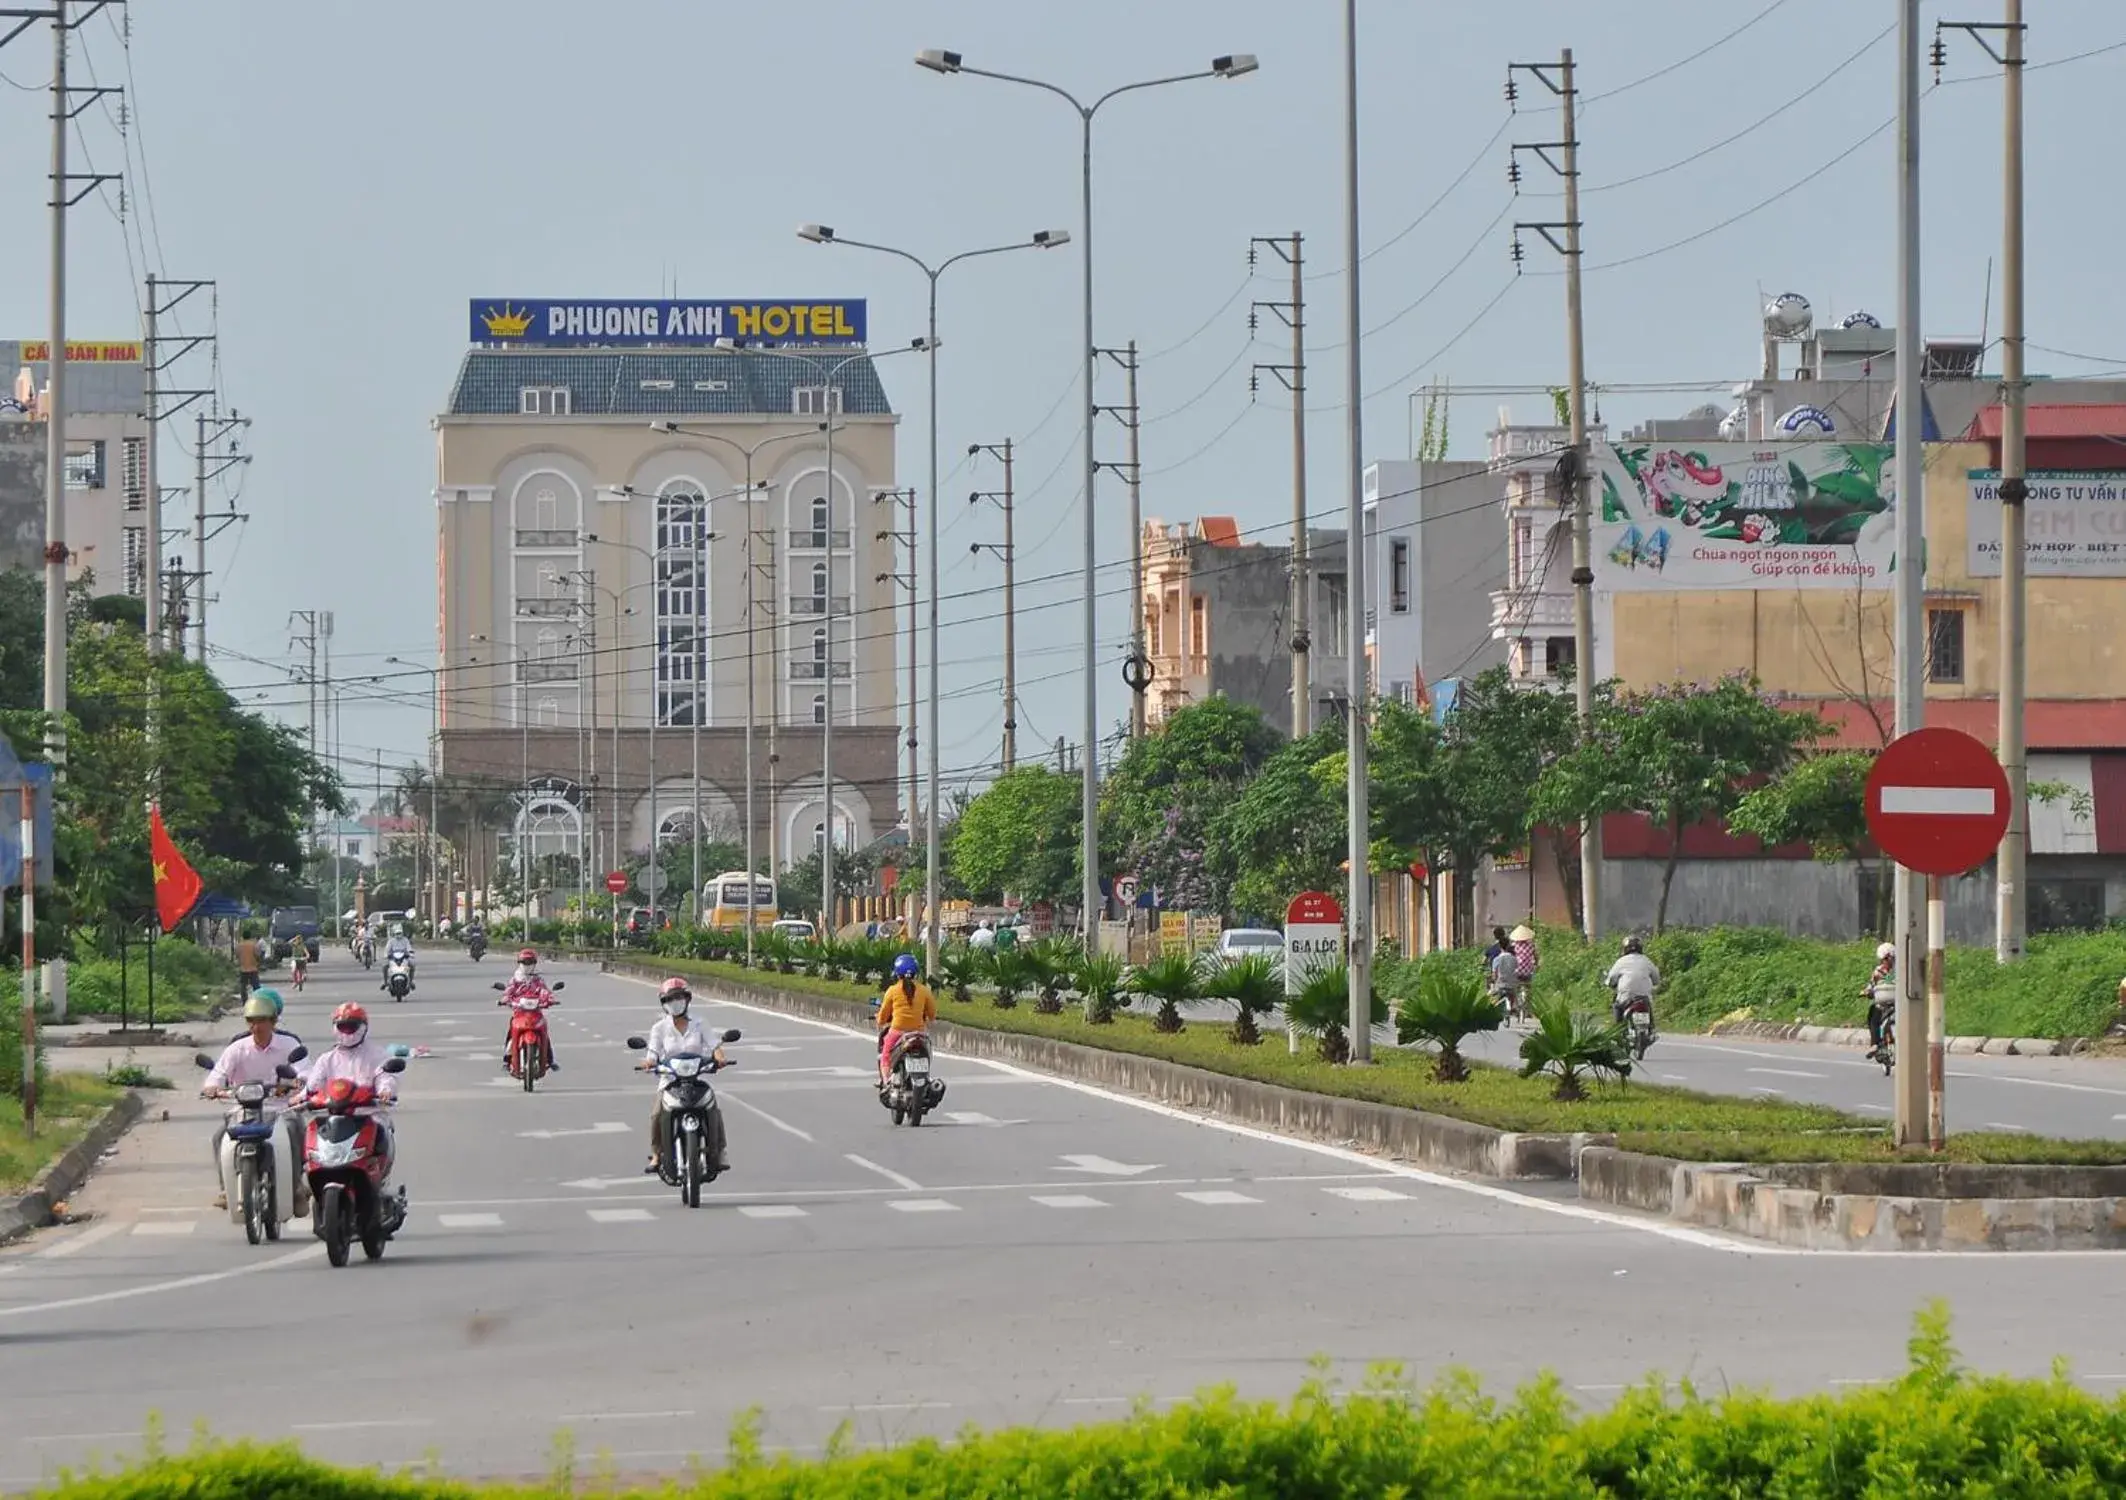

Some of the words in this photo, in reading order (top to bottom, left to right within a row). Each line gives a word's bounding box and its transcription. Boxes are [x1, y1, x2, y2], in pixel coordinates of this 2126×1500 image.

[549, 306, 659, 336] PHUONG
[729, 305, 854, 336] HOTEL
[2026, 482, 2061, 500] ÒNG
[1787, 564, 1810, 575] con
